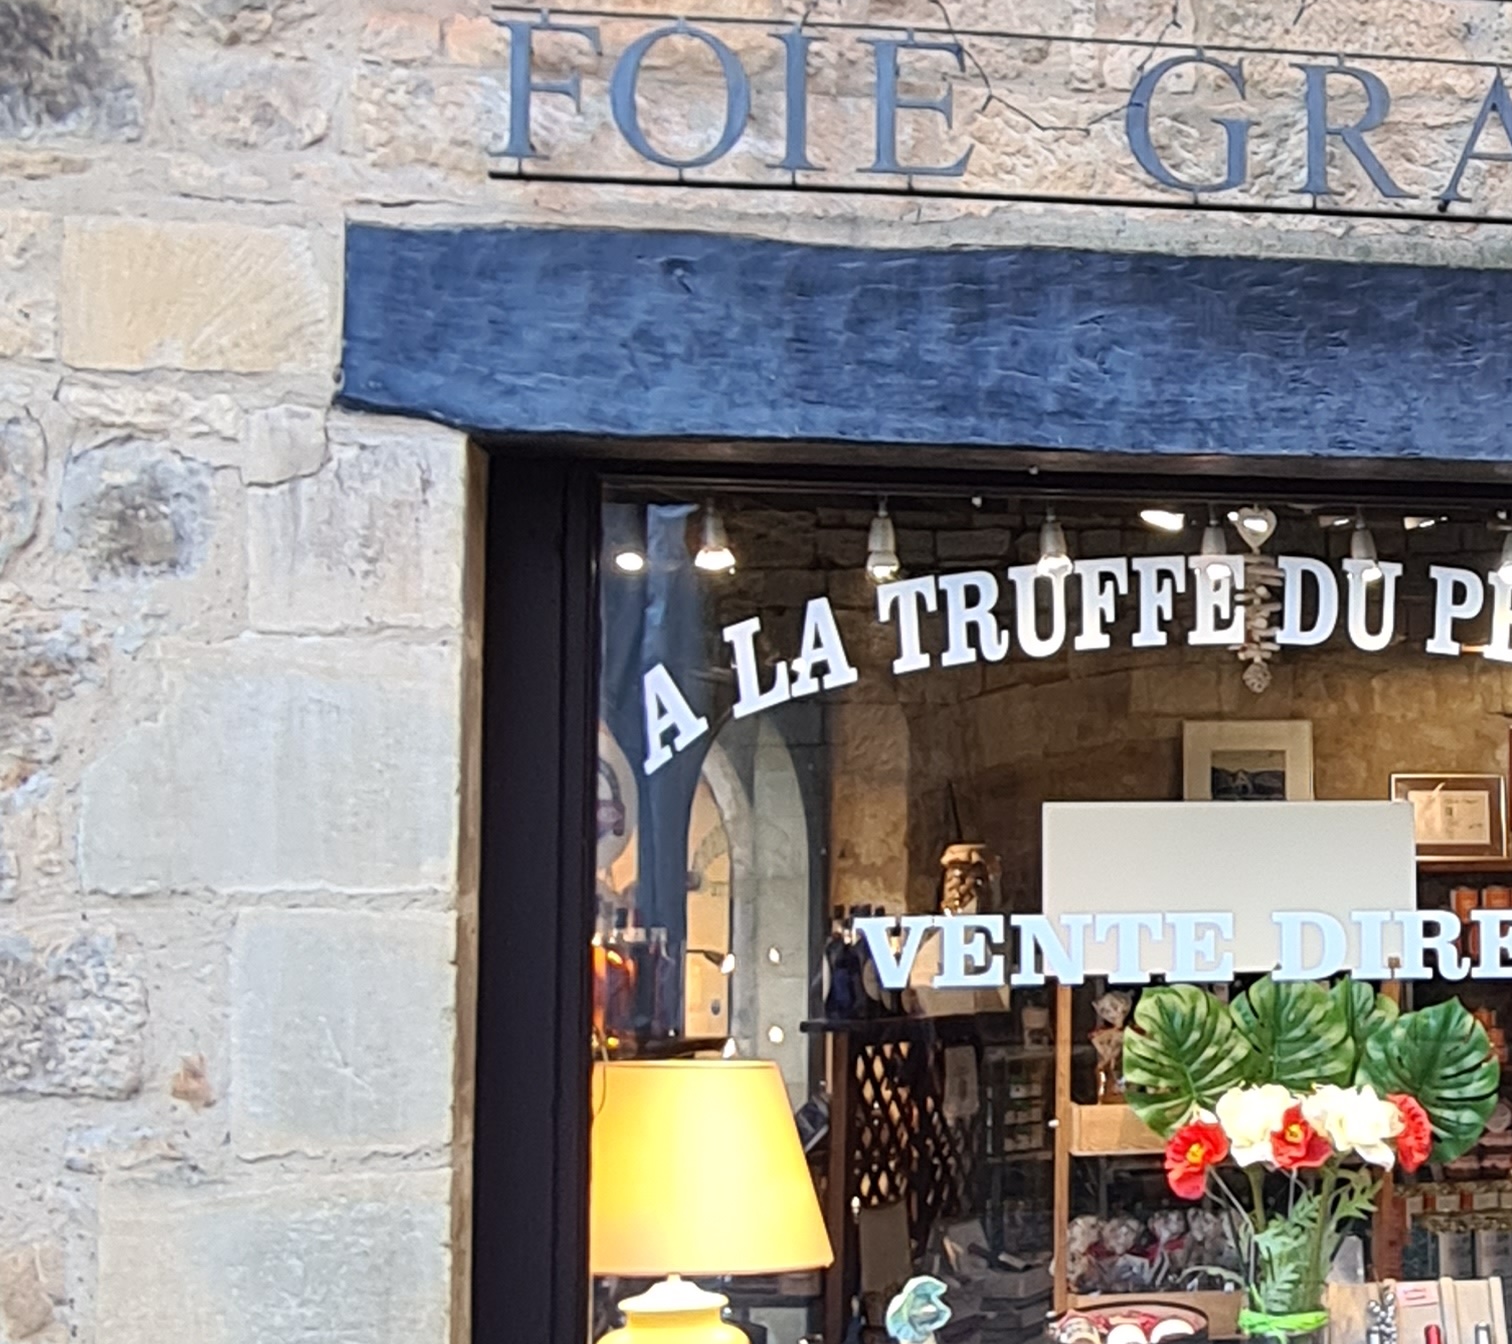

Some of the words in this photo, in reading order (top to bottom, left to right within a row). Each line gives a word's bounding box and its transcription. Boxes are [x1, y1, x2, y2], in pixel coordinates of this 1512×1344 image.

[488, 18, 976, 177] FOIE
[643, 663, 708, 775] A
[722, 596, 858, 719] LA
[877, 555, 1246, 674] TRUFFE
[1275, 556, 1403, 650] DU
[854, 911, 1234, 988] VENTE
